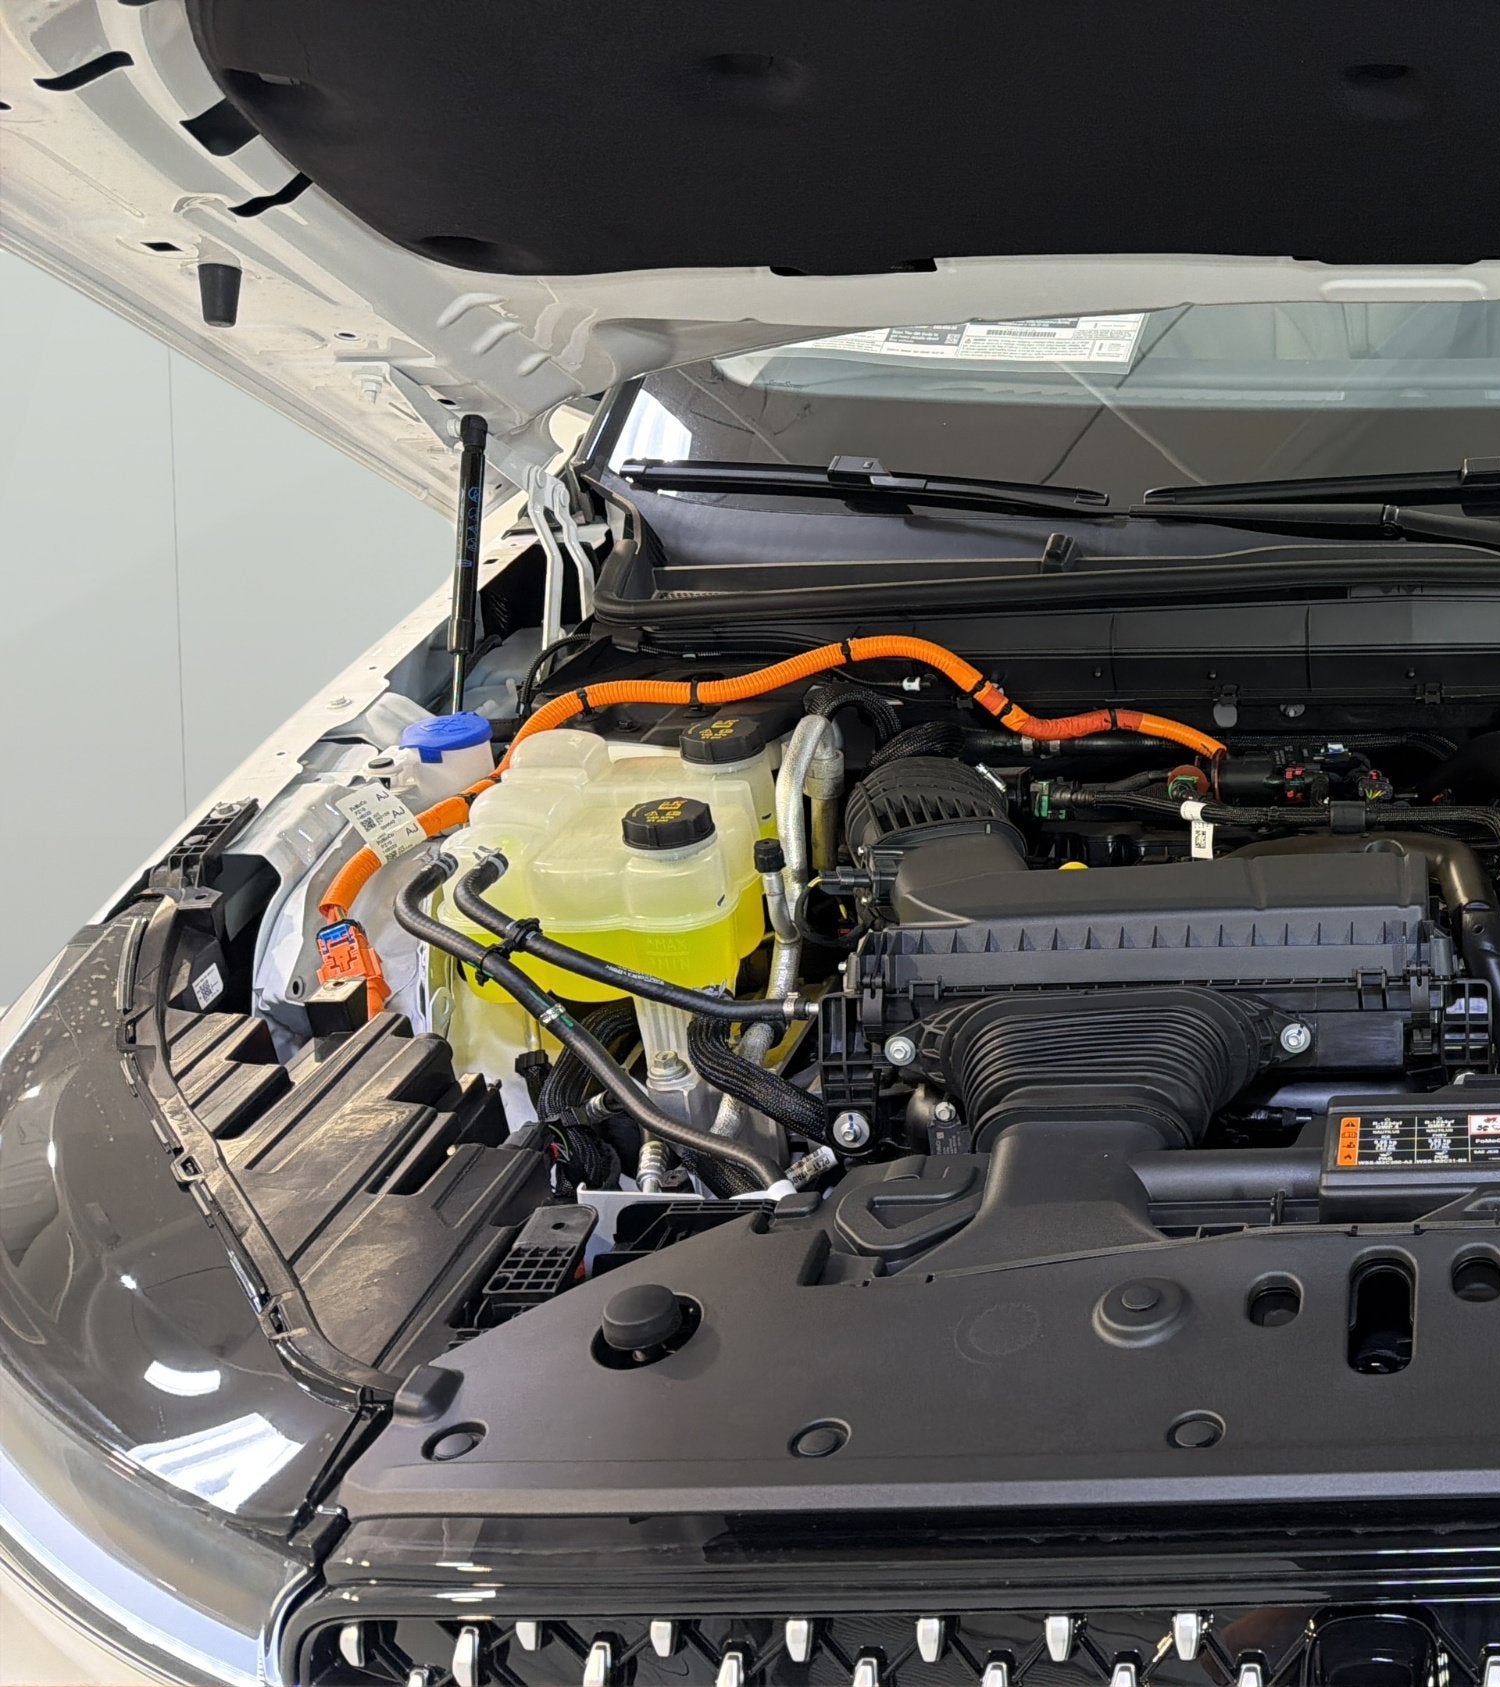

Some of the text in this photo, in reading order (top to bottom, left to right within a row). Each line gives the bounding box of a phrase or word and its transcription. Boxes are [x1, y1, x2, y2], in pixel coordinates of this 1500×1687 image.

[376, 790, 389, 802] AJ
[392, 806, 406, 819] AJ
[406, 822, 419, 837] AJ
